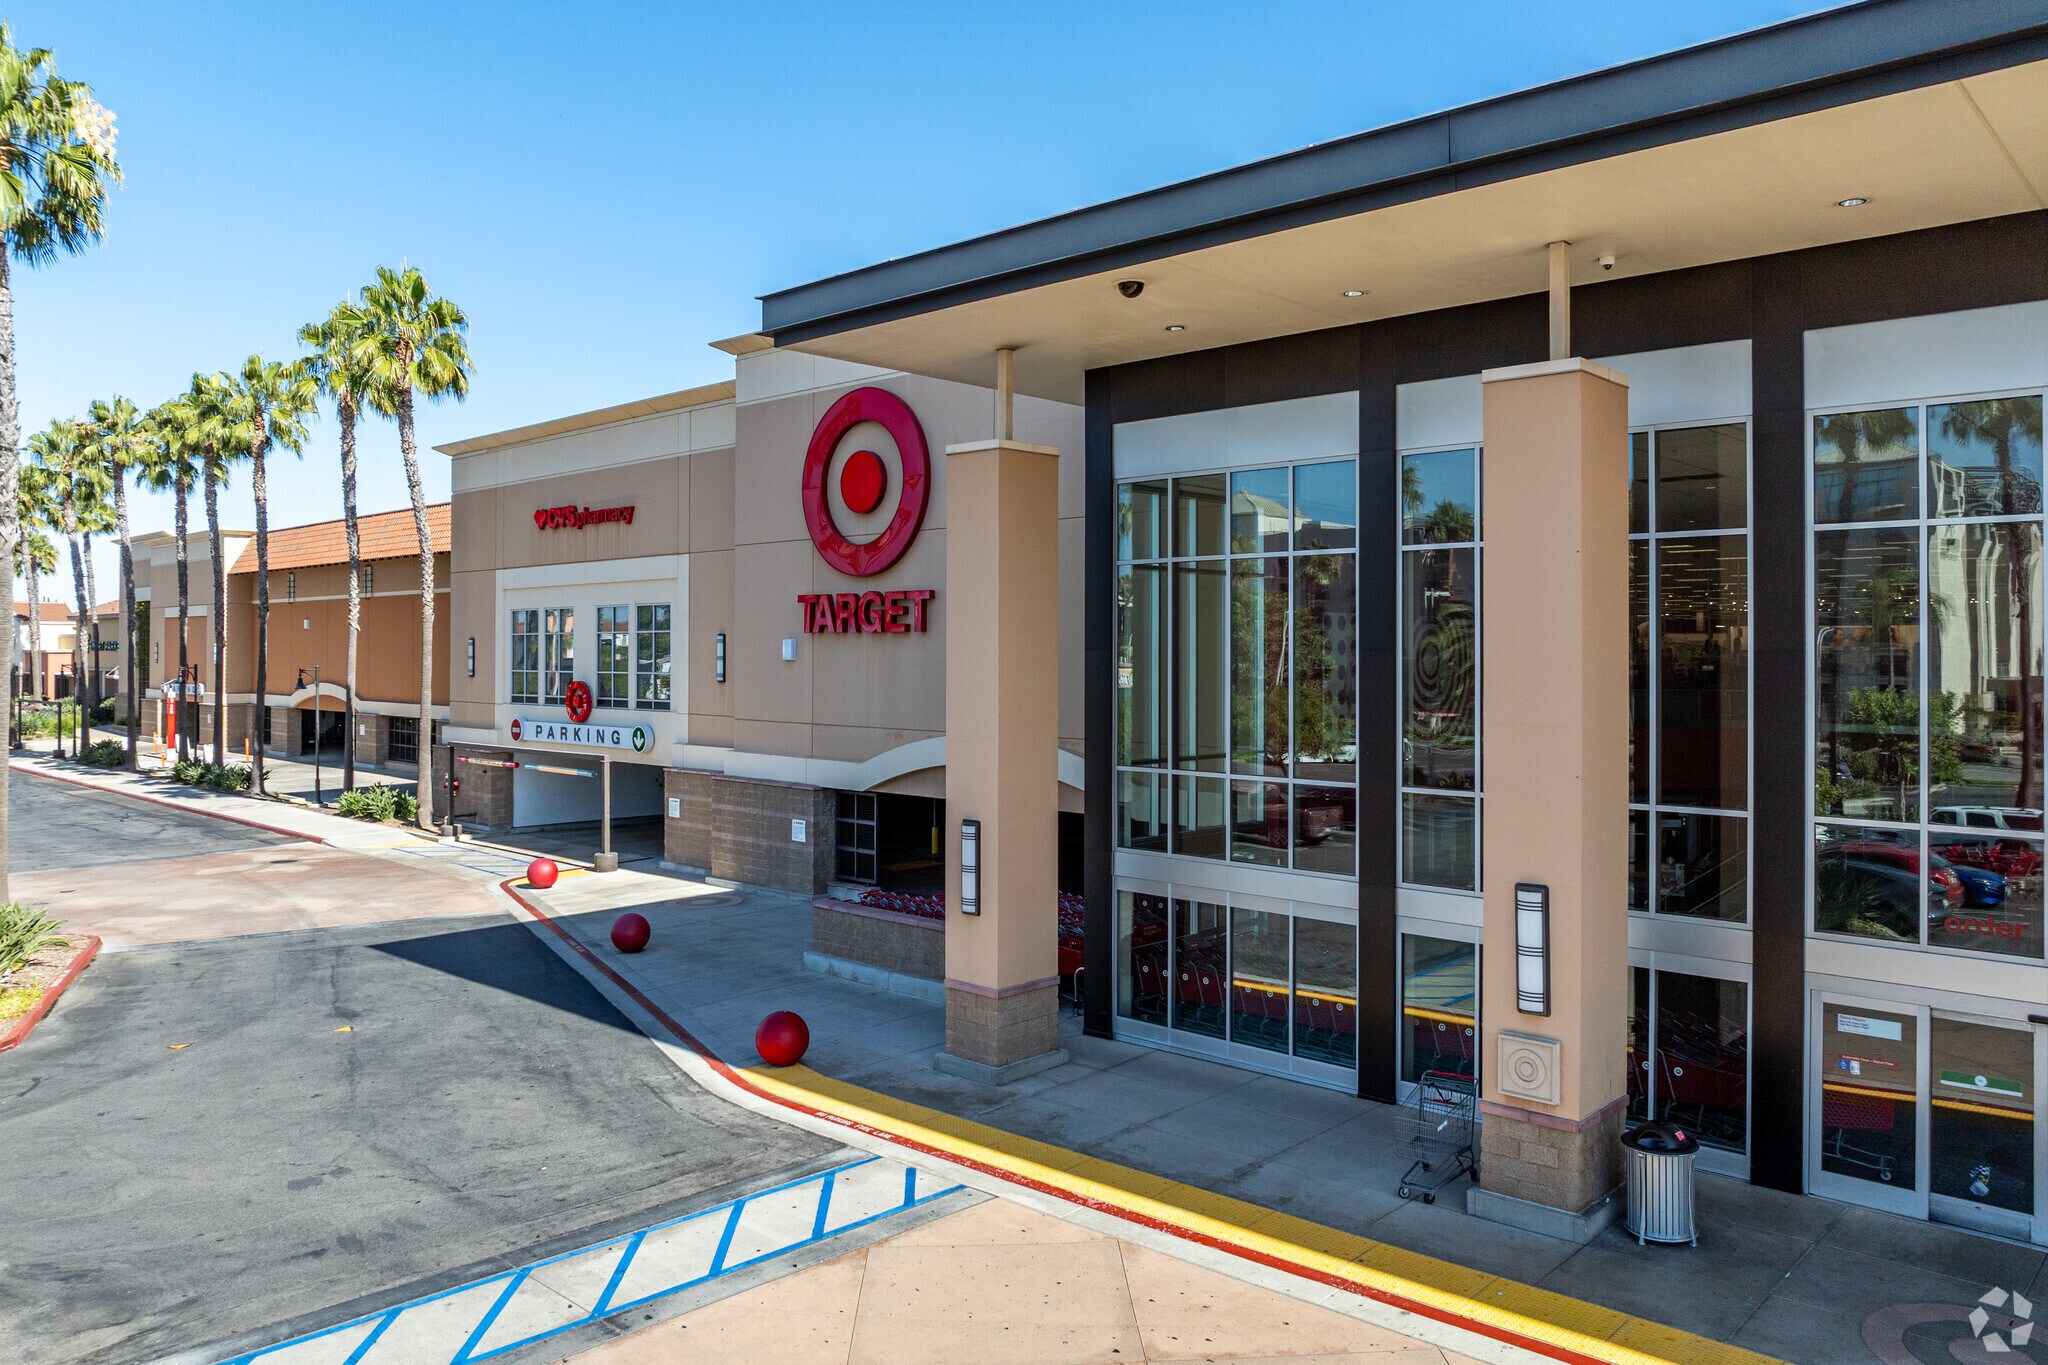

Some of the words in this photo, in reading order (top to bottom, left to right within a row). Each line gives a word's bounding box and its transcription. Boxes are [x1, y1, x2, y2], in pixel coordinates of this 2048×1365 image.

[797, 590, 935, 633] TARGET
[536, 724, 621, 745] PARKING
[1944, 915, 2028, 940] order
[854, 1123, 874, 1133] FIRE
[873, 1130, 895, 1139] LANE
